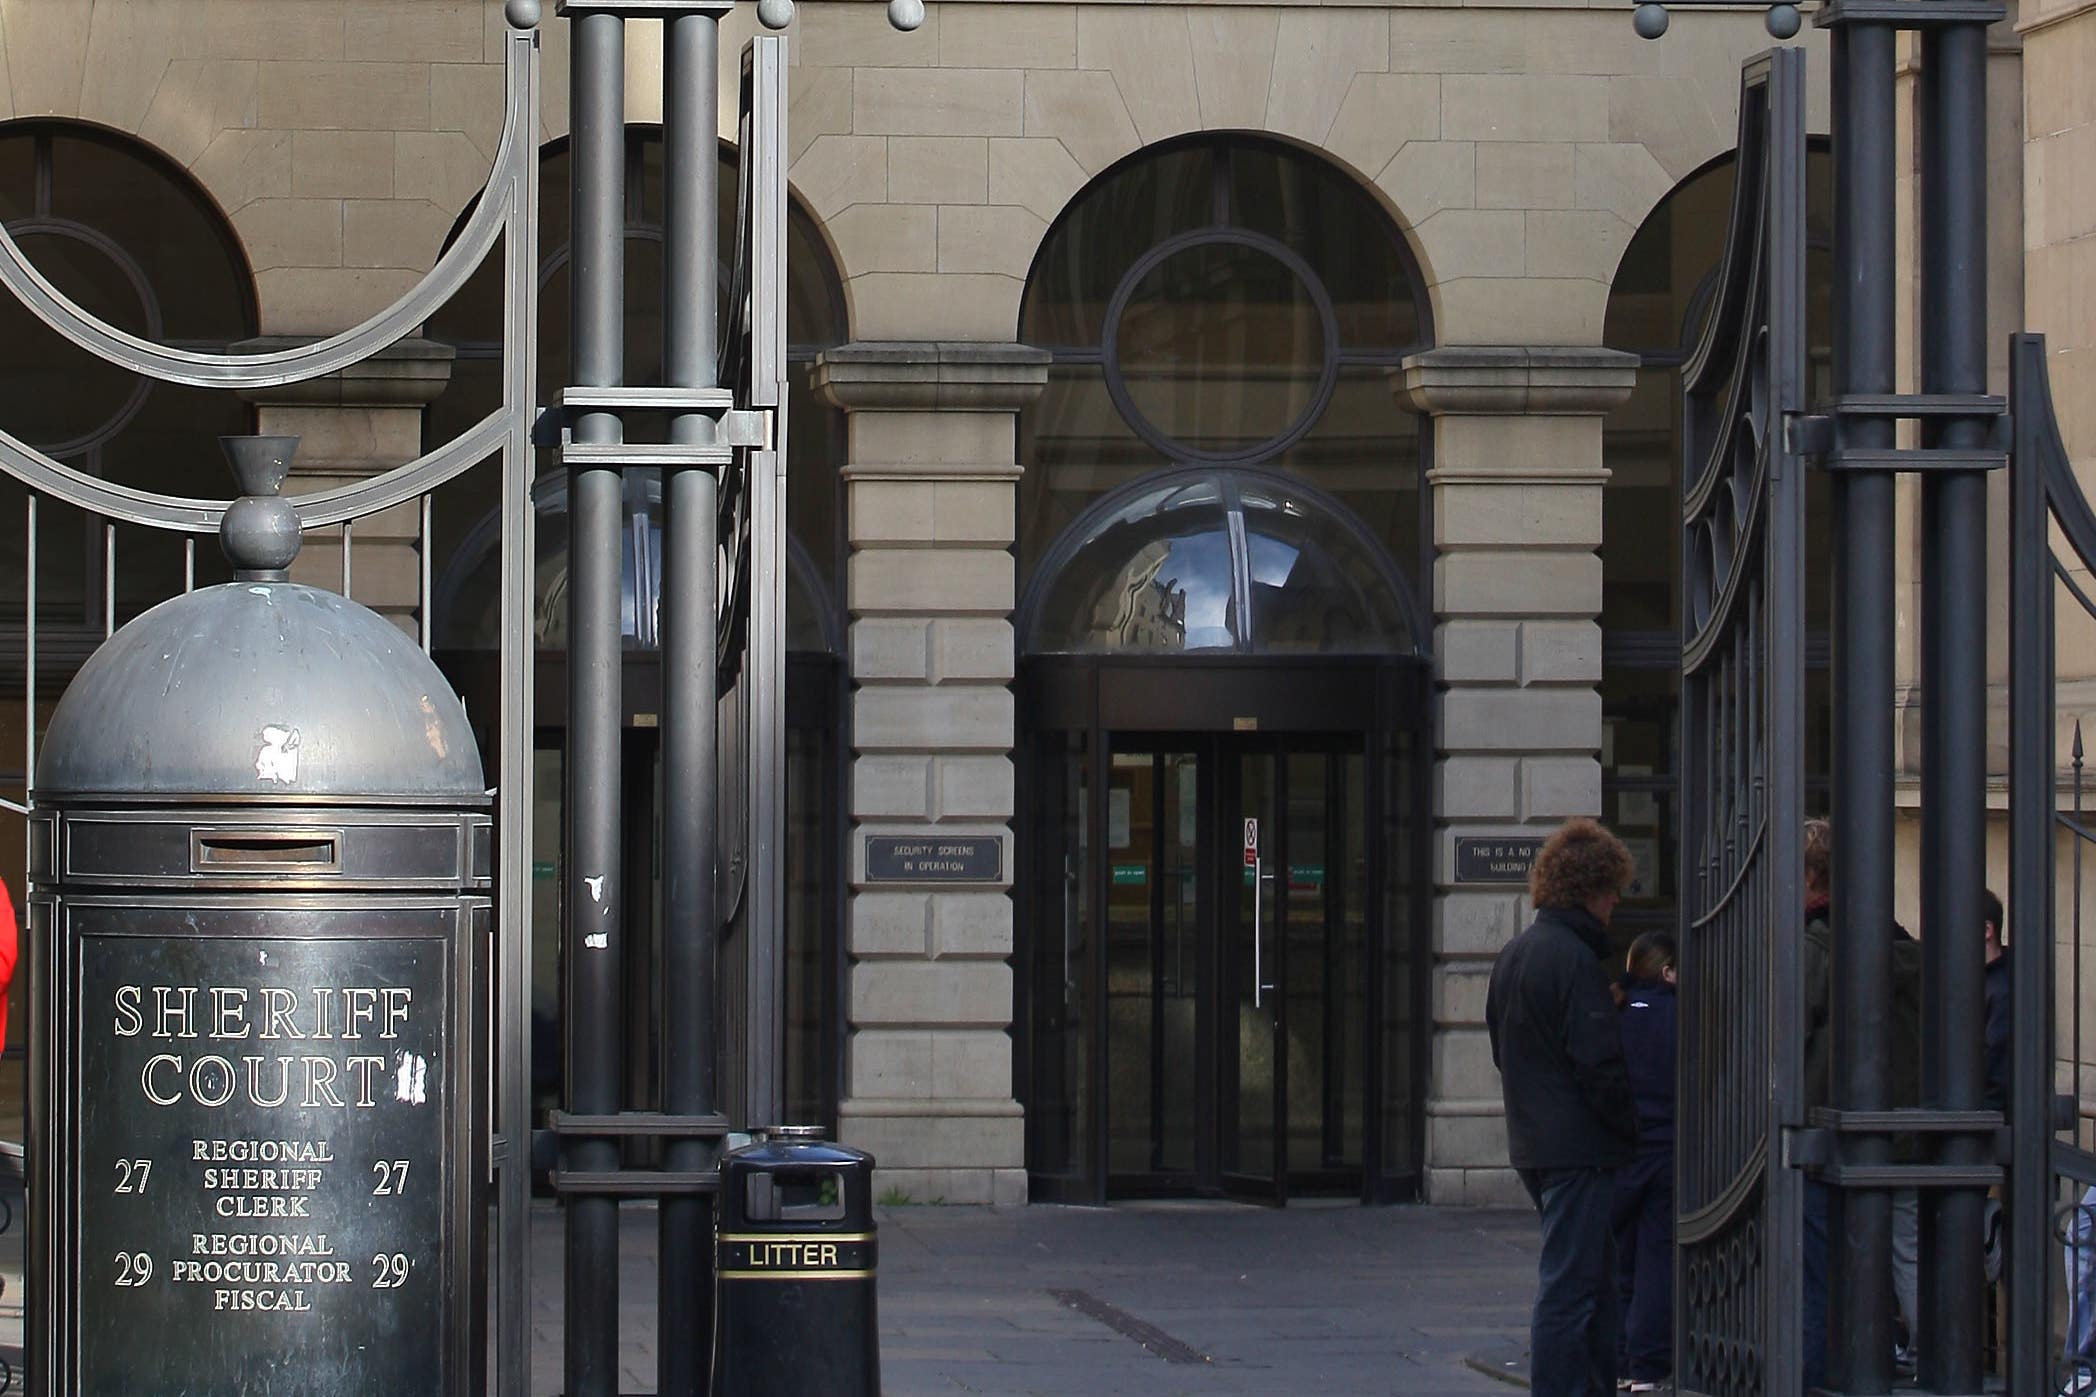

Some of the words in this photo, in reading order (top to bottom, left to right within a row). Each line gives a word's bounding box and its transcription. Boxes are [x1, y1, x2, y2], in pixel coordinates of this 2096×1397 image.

[893, 846, 933, 857] SECURITY
[938, 846, 975, 857] SCREENS
[1473, 847, 1490, 857] THIS
[1495, 847, 1503, 857] IS
[1508, 847, 1514, 857] A
[1518, 847, 1531, 857] NO
[904, 861, 913, 872] IN
[918, 861, 965, 872] OPERATION
[1490, 862, 1526, 873] BUILDING
[114, 985, 413, 1039] SHERIFF
[141, 1055, 385, 1108] COURT
[192, 1140, 334, 1161] REGIONAL
[114, 1159, 152, 1194] 27
[204, 1169, 323, 1190] SHERIFF
[372, 1160, 410, 1195] 27
[216, 1196, 310, 1217] CLERK
[192, 1234, 334, 1256] REGIONAL
[749, 1244, 838, 1265] LITTER
[114, 1252, 153, 1286] 29
[172, 1260, 352, 1283] PROCURATOR
[372, 1253, 409, 1288] 29
[214, 1290, 311, 1311] FISCAL
